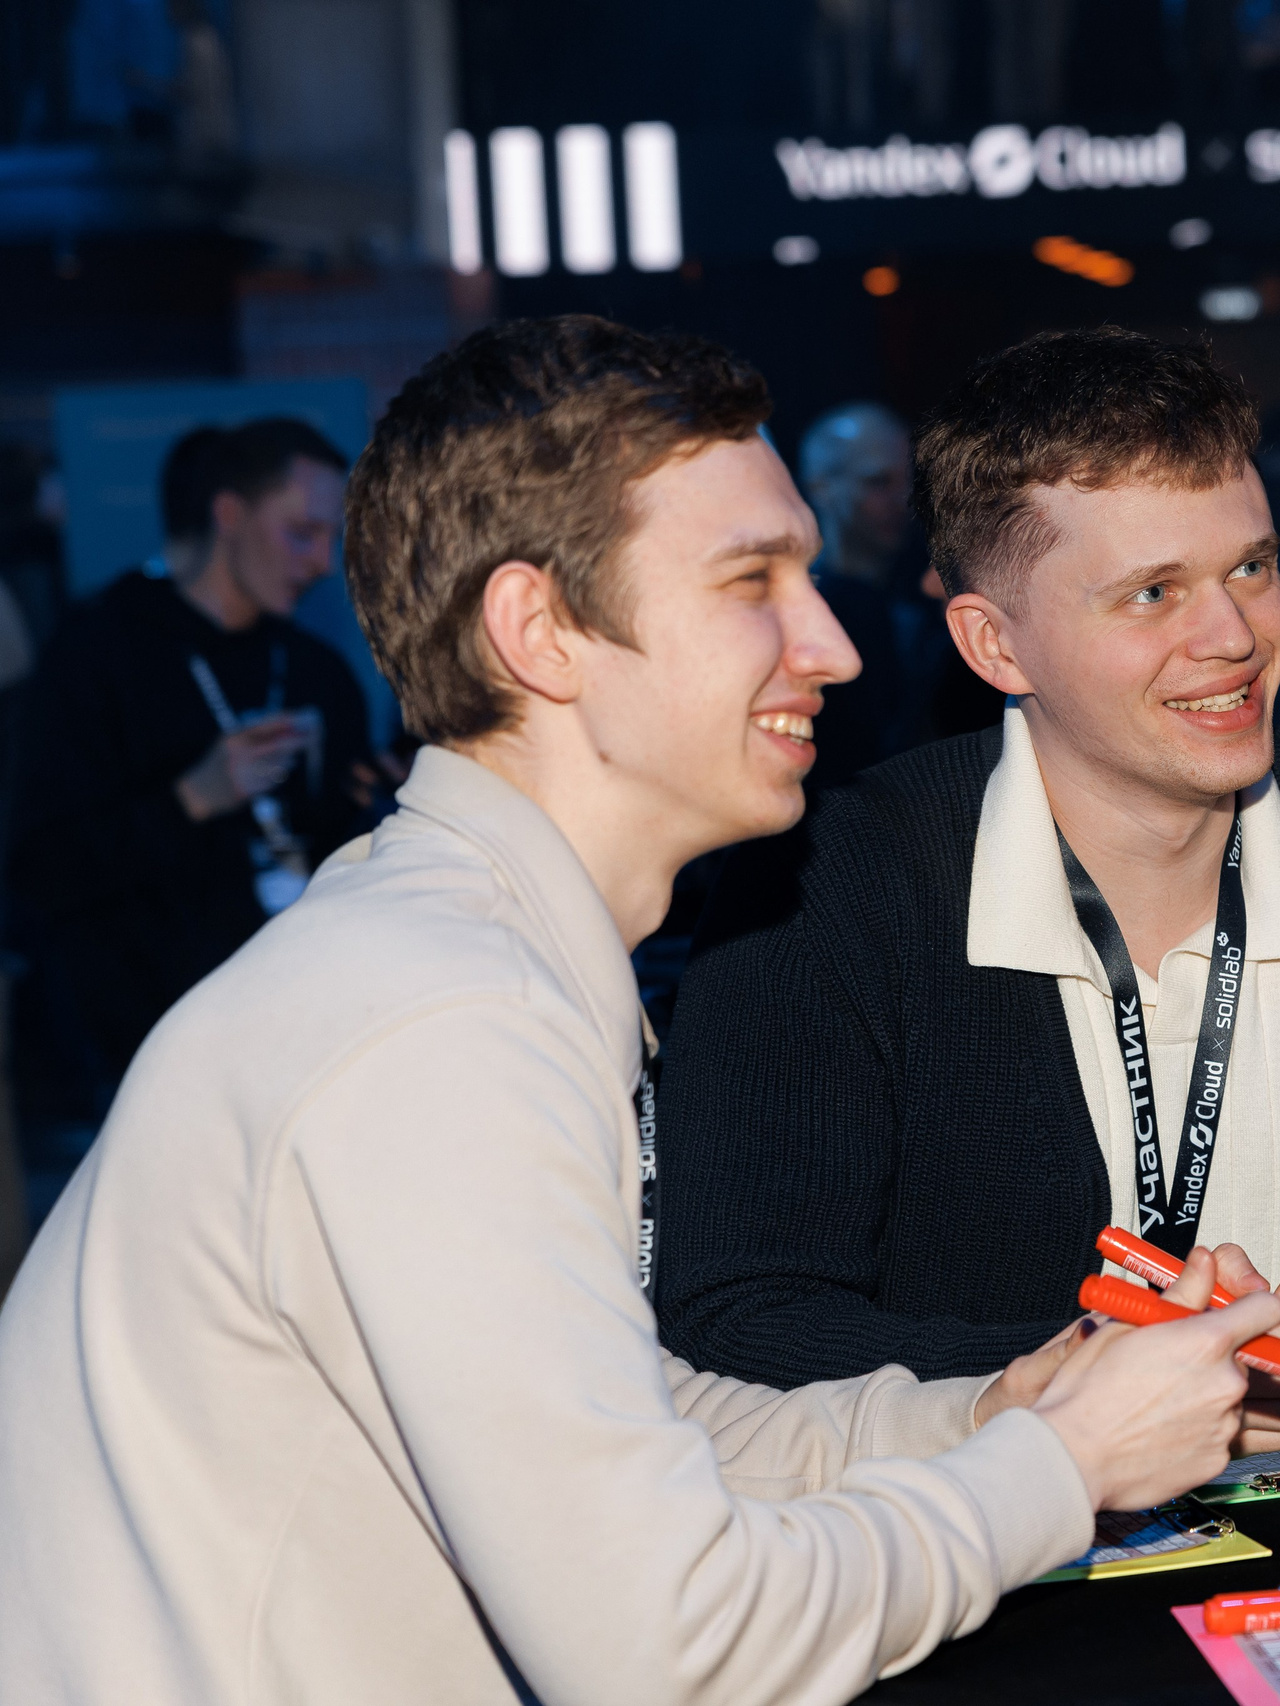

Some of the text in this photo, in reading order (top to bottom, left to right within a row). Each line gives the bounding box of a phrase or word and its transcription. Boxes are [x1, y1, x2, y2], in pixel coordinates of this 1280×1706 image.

[1034, 122, 1187, 191] Cloud
[1119, 995, 1164, 1236] Участник
[1175, 1153, 1208, 1226] Yandex
[1195, 1060, 1224, 1120] Cloud
[1215, 947, 1242, 1029] solidlab
